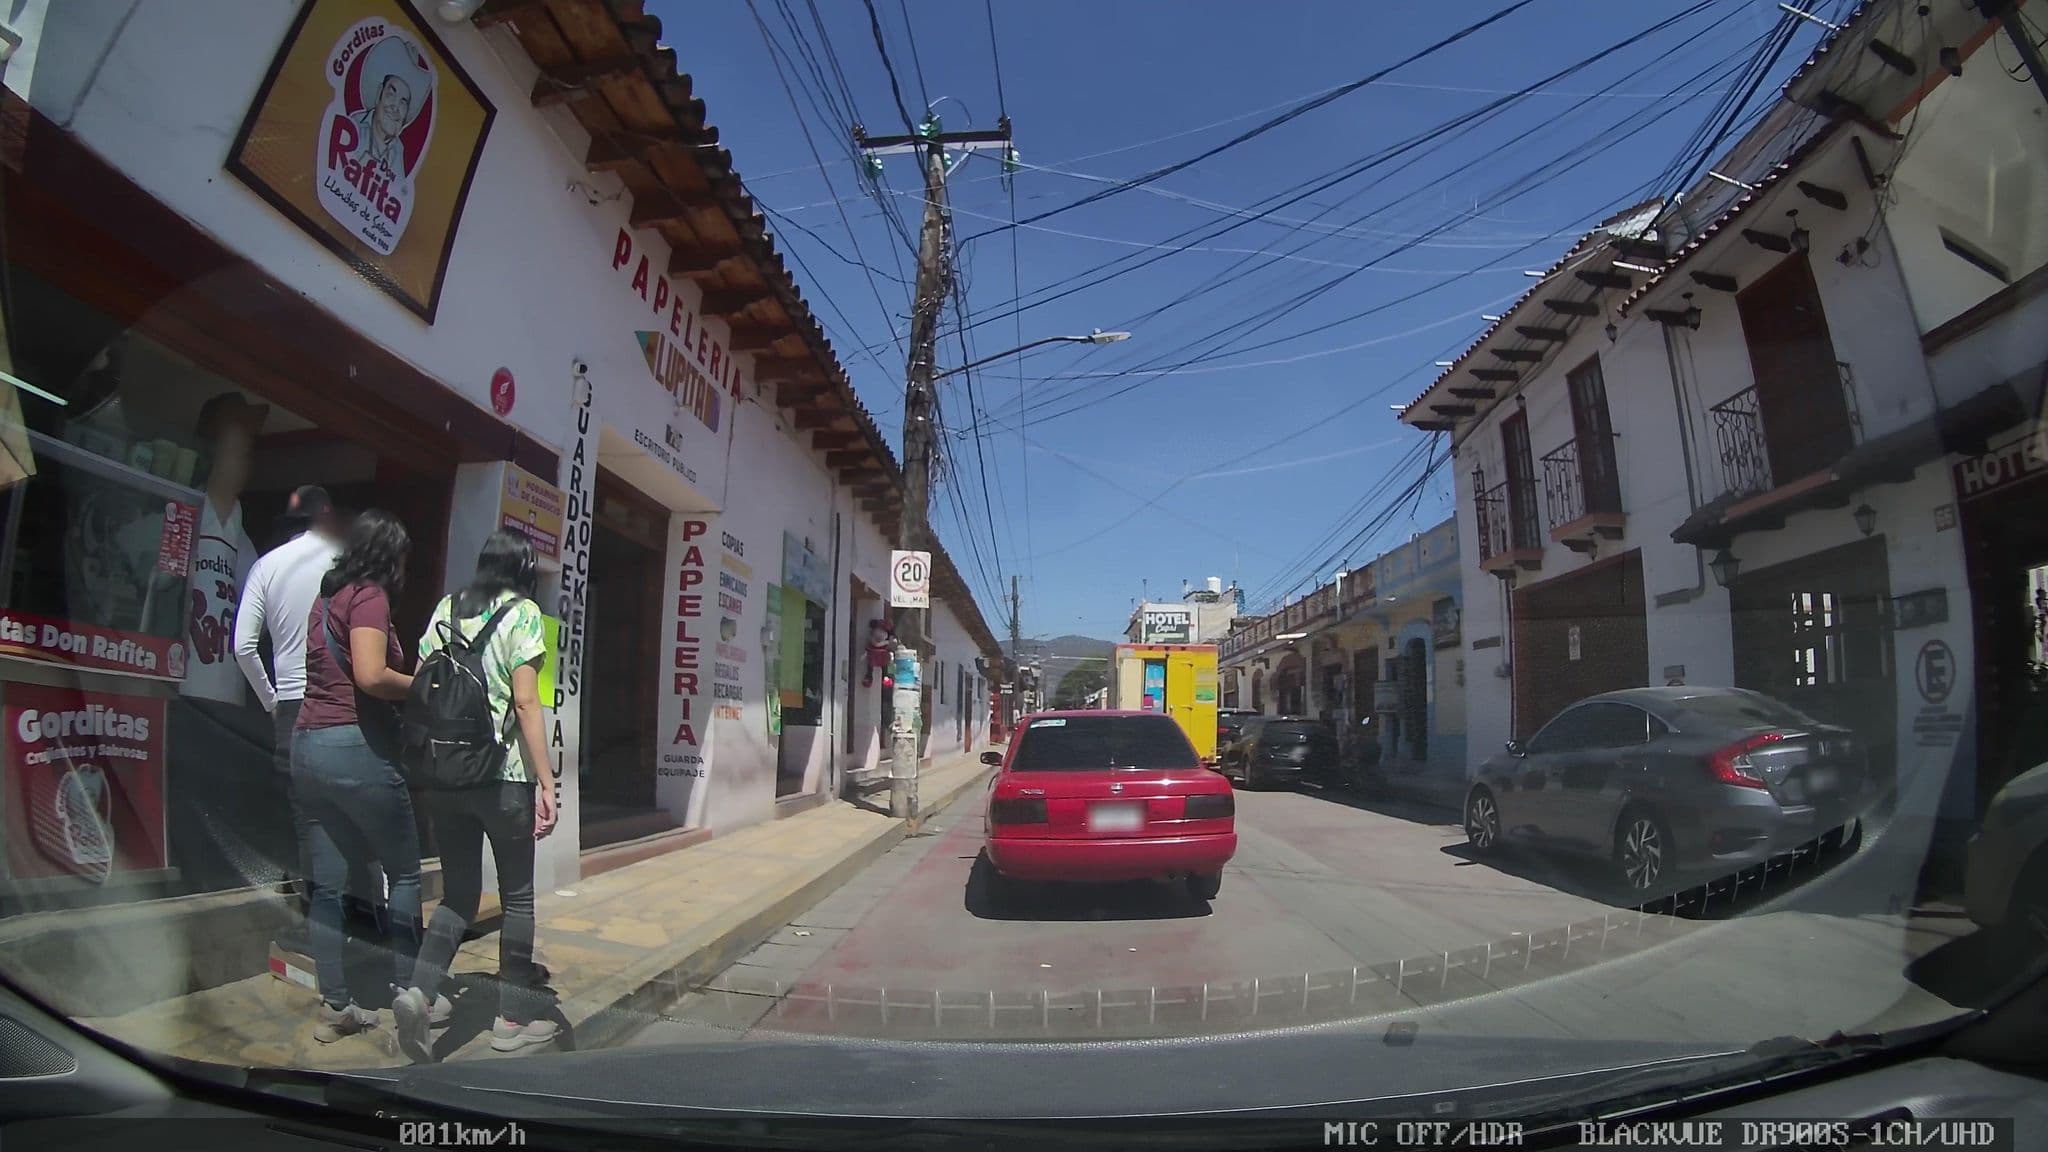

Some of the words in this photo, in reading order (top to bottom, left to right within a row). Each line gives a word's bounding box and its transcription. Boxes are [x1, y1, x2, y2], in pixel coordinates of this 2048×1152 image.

[333, 24, 385, 77] Gorditas
[328, 114, 402, 225] Rafita
[360, 206, 370, 222] de
[612, 226, 741, 404] PAPELERIA
[634, 428, 671, 464] ESCRITORIO
[722, 531, 744, 557] COPIAS
[195, 555, 236, 578] ordita
[901, 562, 922, 582] 20
[568, 491, 591, 696] LOCKERS
[1145, 613, 1190, 625] HOTEL
[0, 615, 36, 644] tas
[41, 624, 87, 654] Don
[91, 636, 158, 671] Rafita
[672, 520, 708, 746] PAPELERIA
[714, 683, 743, 701] RECARGAS
[18, 704, 150, 743] Gorditas
[714, 704, 743, 721] INTERNET
[658, 767, 705, 778] EQUIPAJE
[664, 754, 705, 765] GUARDA
